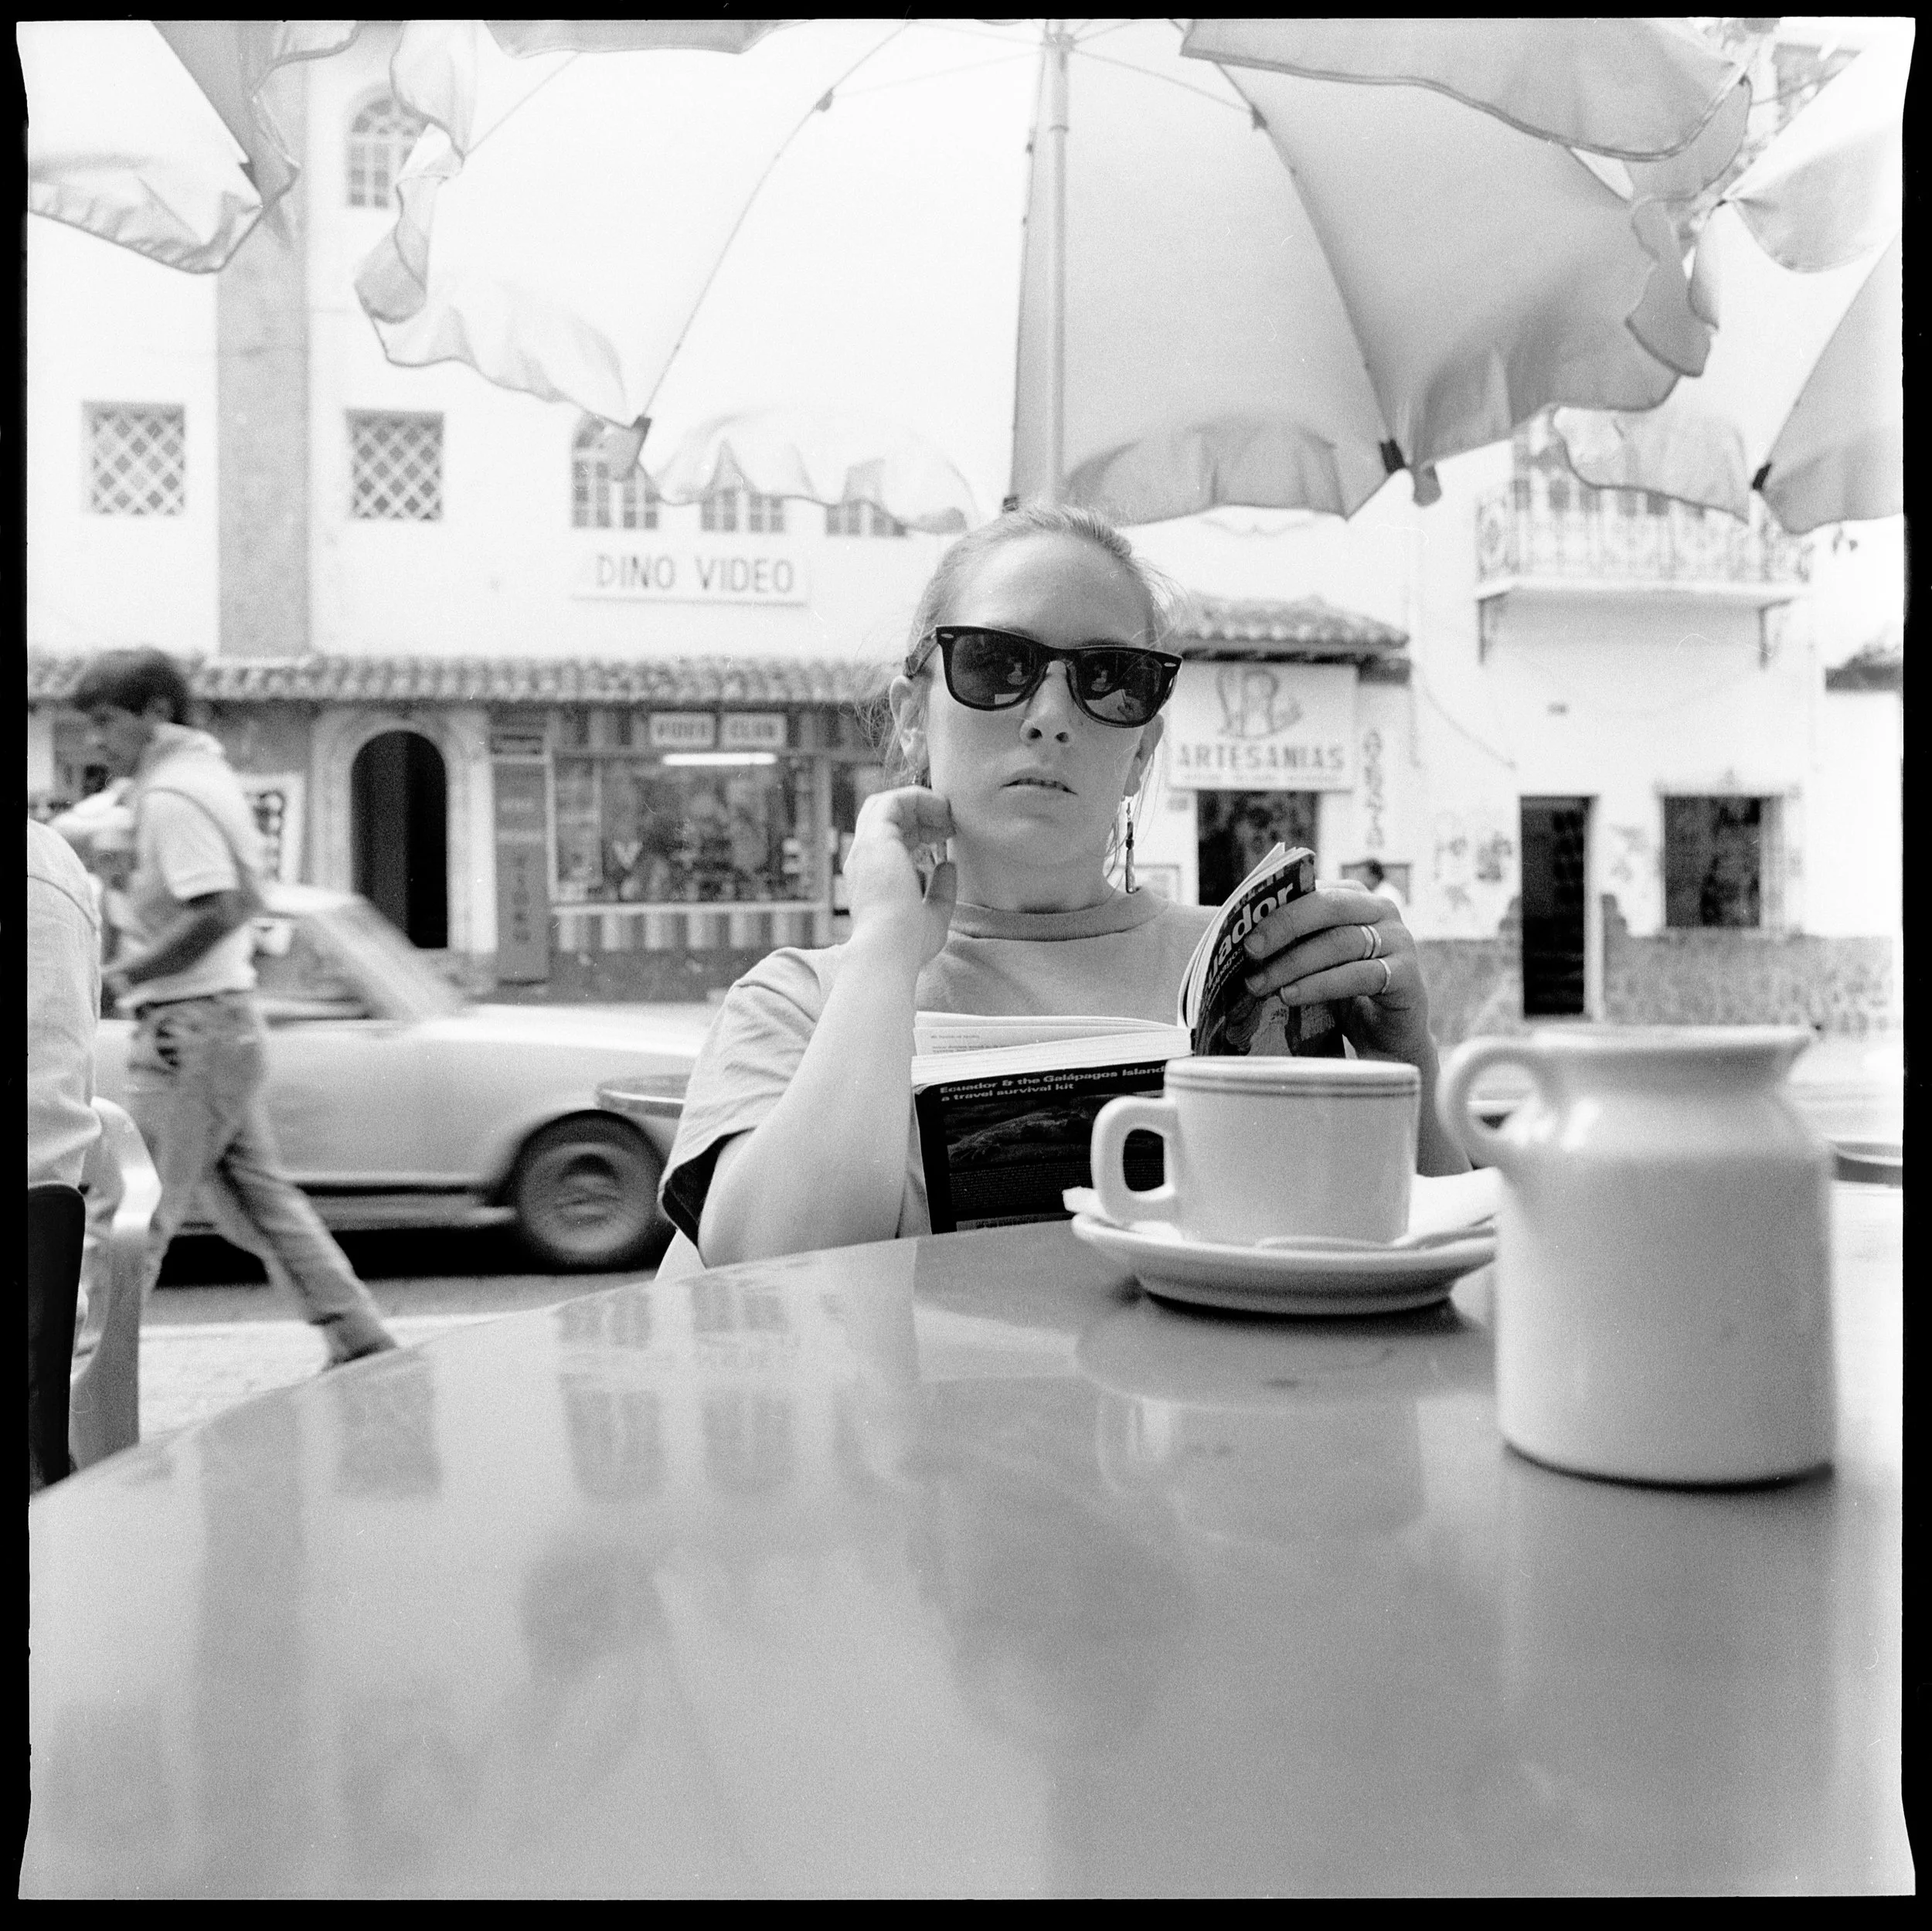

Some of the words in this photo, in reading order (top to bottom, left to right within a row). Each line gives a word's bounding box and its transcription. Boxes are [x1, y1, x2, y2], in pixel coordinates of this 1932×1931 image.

[596, 553, 675, 590] DINO
[696, 556, 794, 593] VIDEO
[1179, 743, 1345, 770] ARTESANIAS
[940, 1082, 998, 1093] Ecuador
[1043, 1072, 1117, 1083] Galápagos
[1122, 1066, 1165, 1076] Island
[953, 1090, 993, 1100] travel
[996, 1084, 1051, 1096] survival
